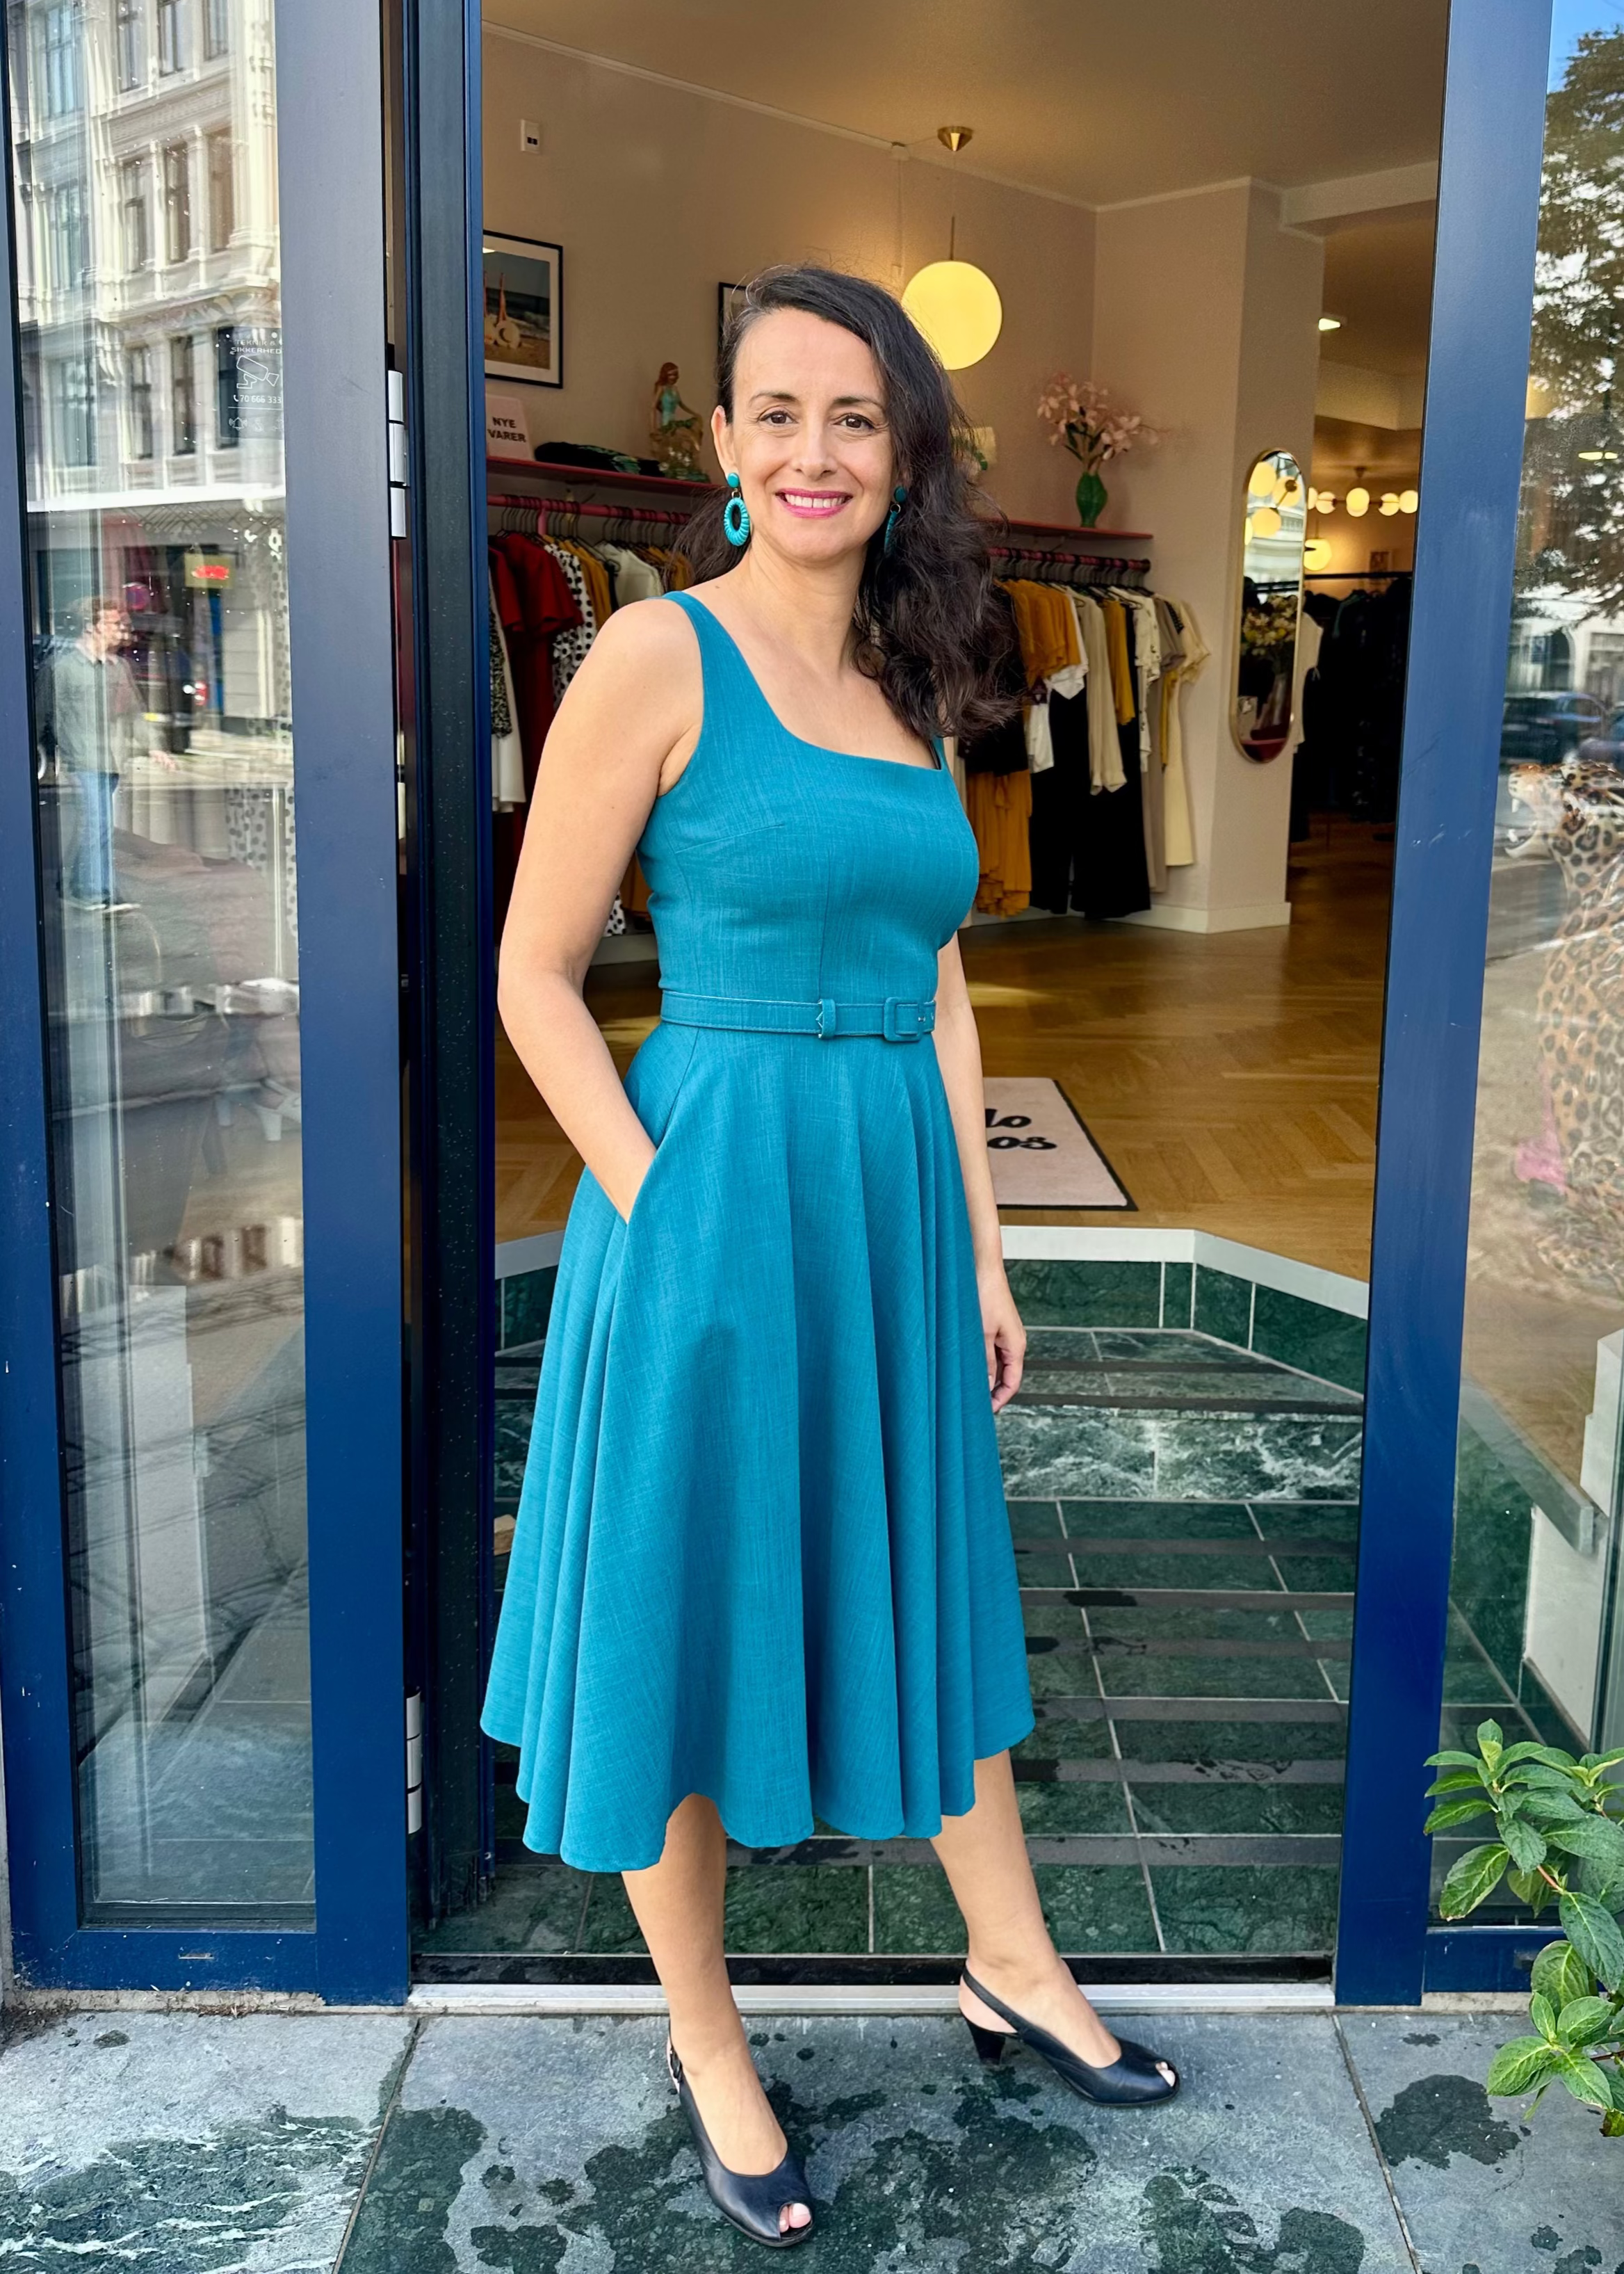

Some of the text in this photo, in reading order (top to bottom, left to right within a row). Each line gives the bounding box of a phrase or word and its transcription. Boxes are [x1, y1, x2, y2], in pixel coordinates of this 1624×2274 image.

[240, 394, 250, 403] 70
[492, 417, 517, 428] NYE
[487, 428, 526, 443] VARER
